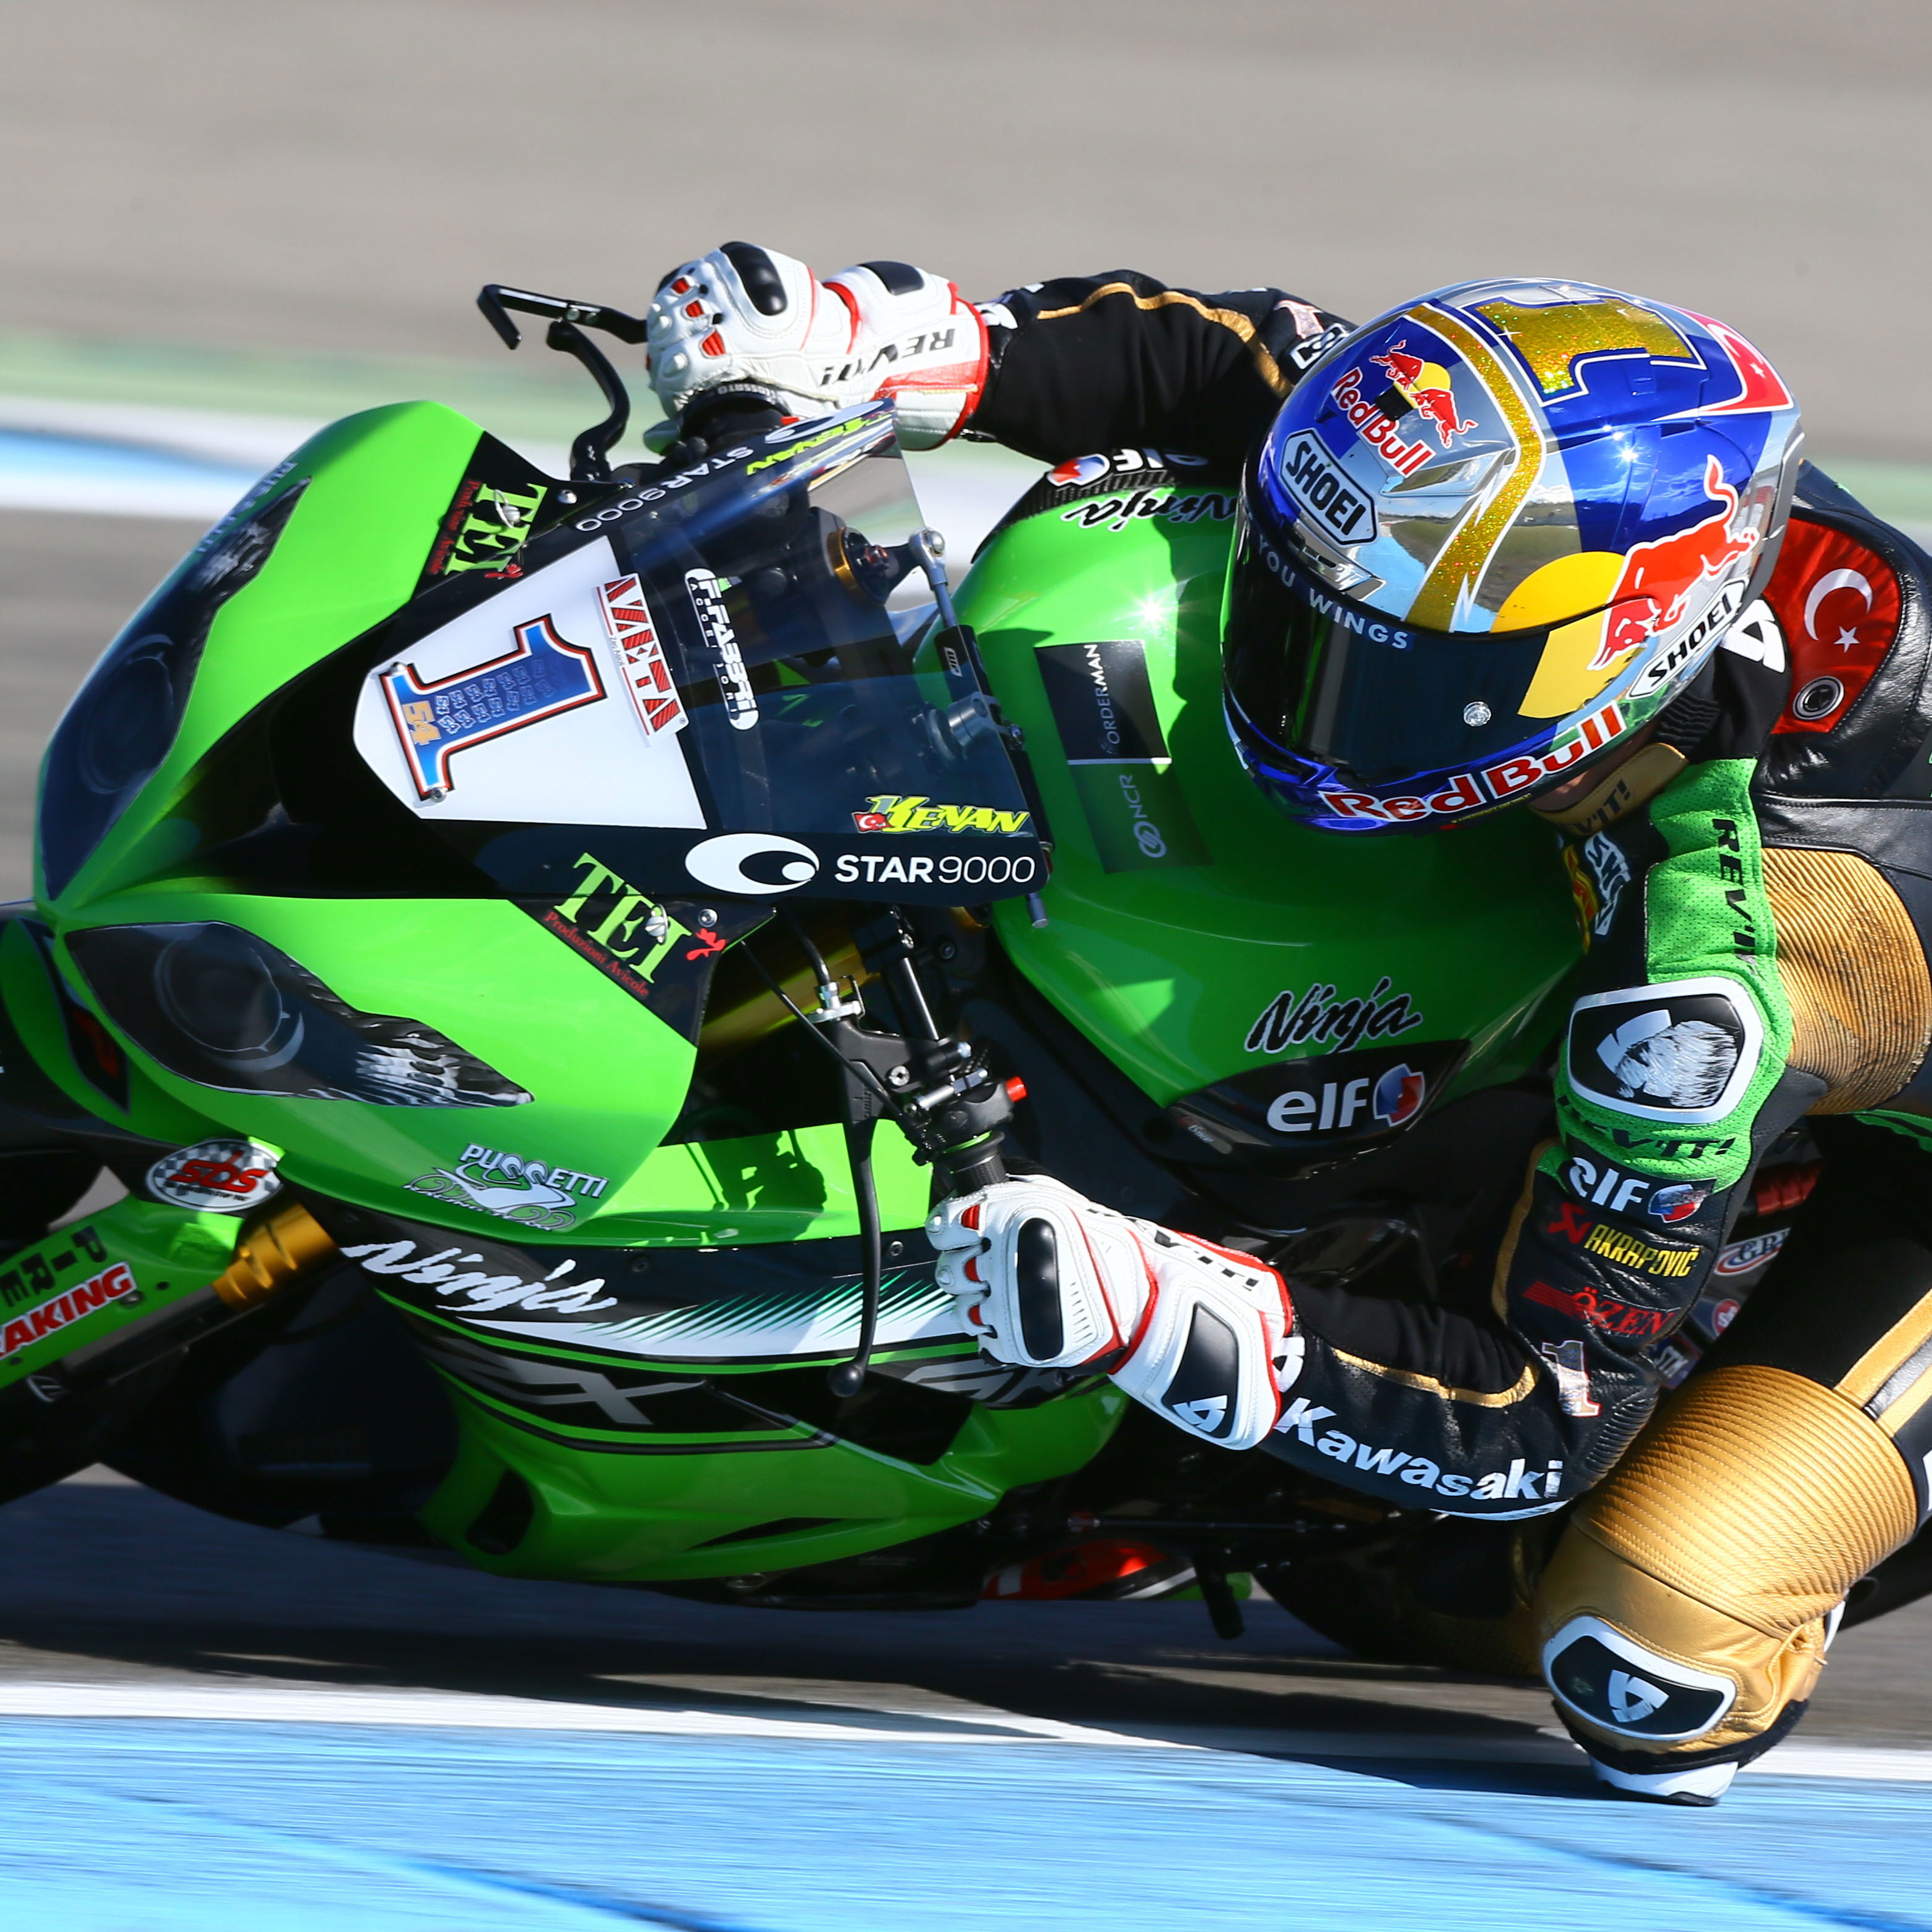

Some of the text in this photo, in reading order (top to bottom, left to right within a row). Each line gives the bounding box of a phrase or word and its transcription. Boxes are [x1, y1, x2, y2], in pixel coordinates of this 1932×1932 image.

[1330, 367, 1437, 478] Red Bull
[444, 483, 548, 575] TEI
[1285, 441, 1366, 535] SHOEI
[1259, 534, 1408, 649] YOU WINGS
[1648, 592, 1731, 687] SHOEI
[379, 613, 608, 802] 1
[402, 700, 441, 745] 54
[1084, 644, 1120, 745] ORDERMAN
[1119, 774, 1147, 818] NCR
[1319, 773, 1486, 822] Red
[1482, 700, 1627, 798] Bull
[865, 795, 1030, 833] KENAN
[553, 852, 692, 984] TEI
[1244, 976, 1422, 1055] Ninja
[1267, 1078, 1369, 1132] elf
[1569, 1157, 1650, 1212] elf
[0, 1262, 136, 1357] AKING
[341, 1240, 617, 1314] Ninja
[1273, 1398, 1563, 1500] Kawasaki
